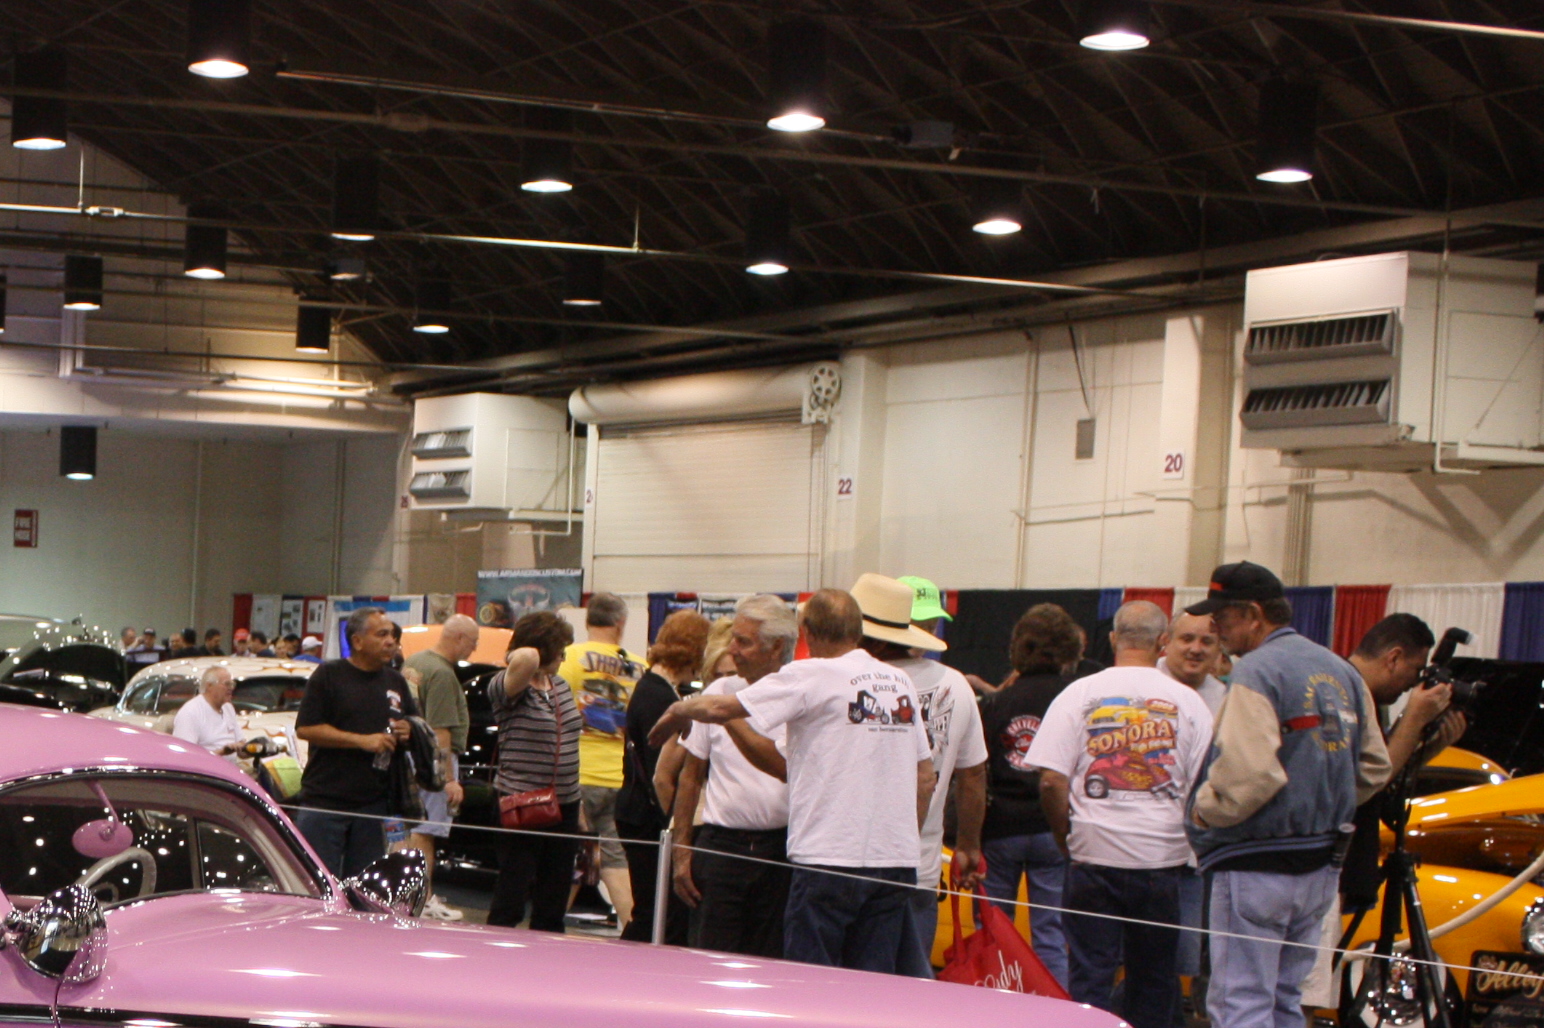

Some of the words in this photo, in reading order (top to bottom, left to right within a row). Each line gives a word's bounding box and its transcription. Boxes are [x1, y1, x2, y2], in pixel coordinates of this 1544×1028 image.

[1164, 453, 1183, 473] 20
[838, 478, 852, 495] 22
[850, 673, 872, 686] over
[873, 671, 892, 681] the
[872, 684, 898, 693] gang
[1087, 719, 1173, 757] SONORA
